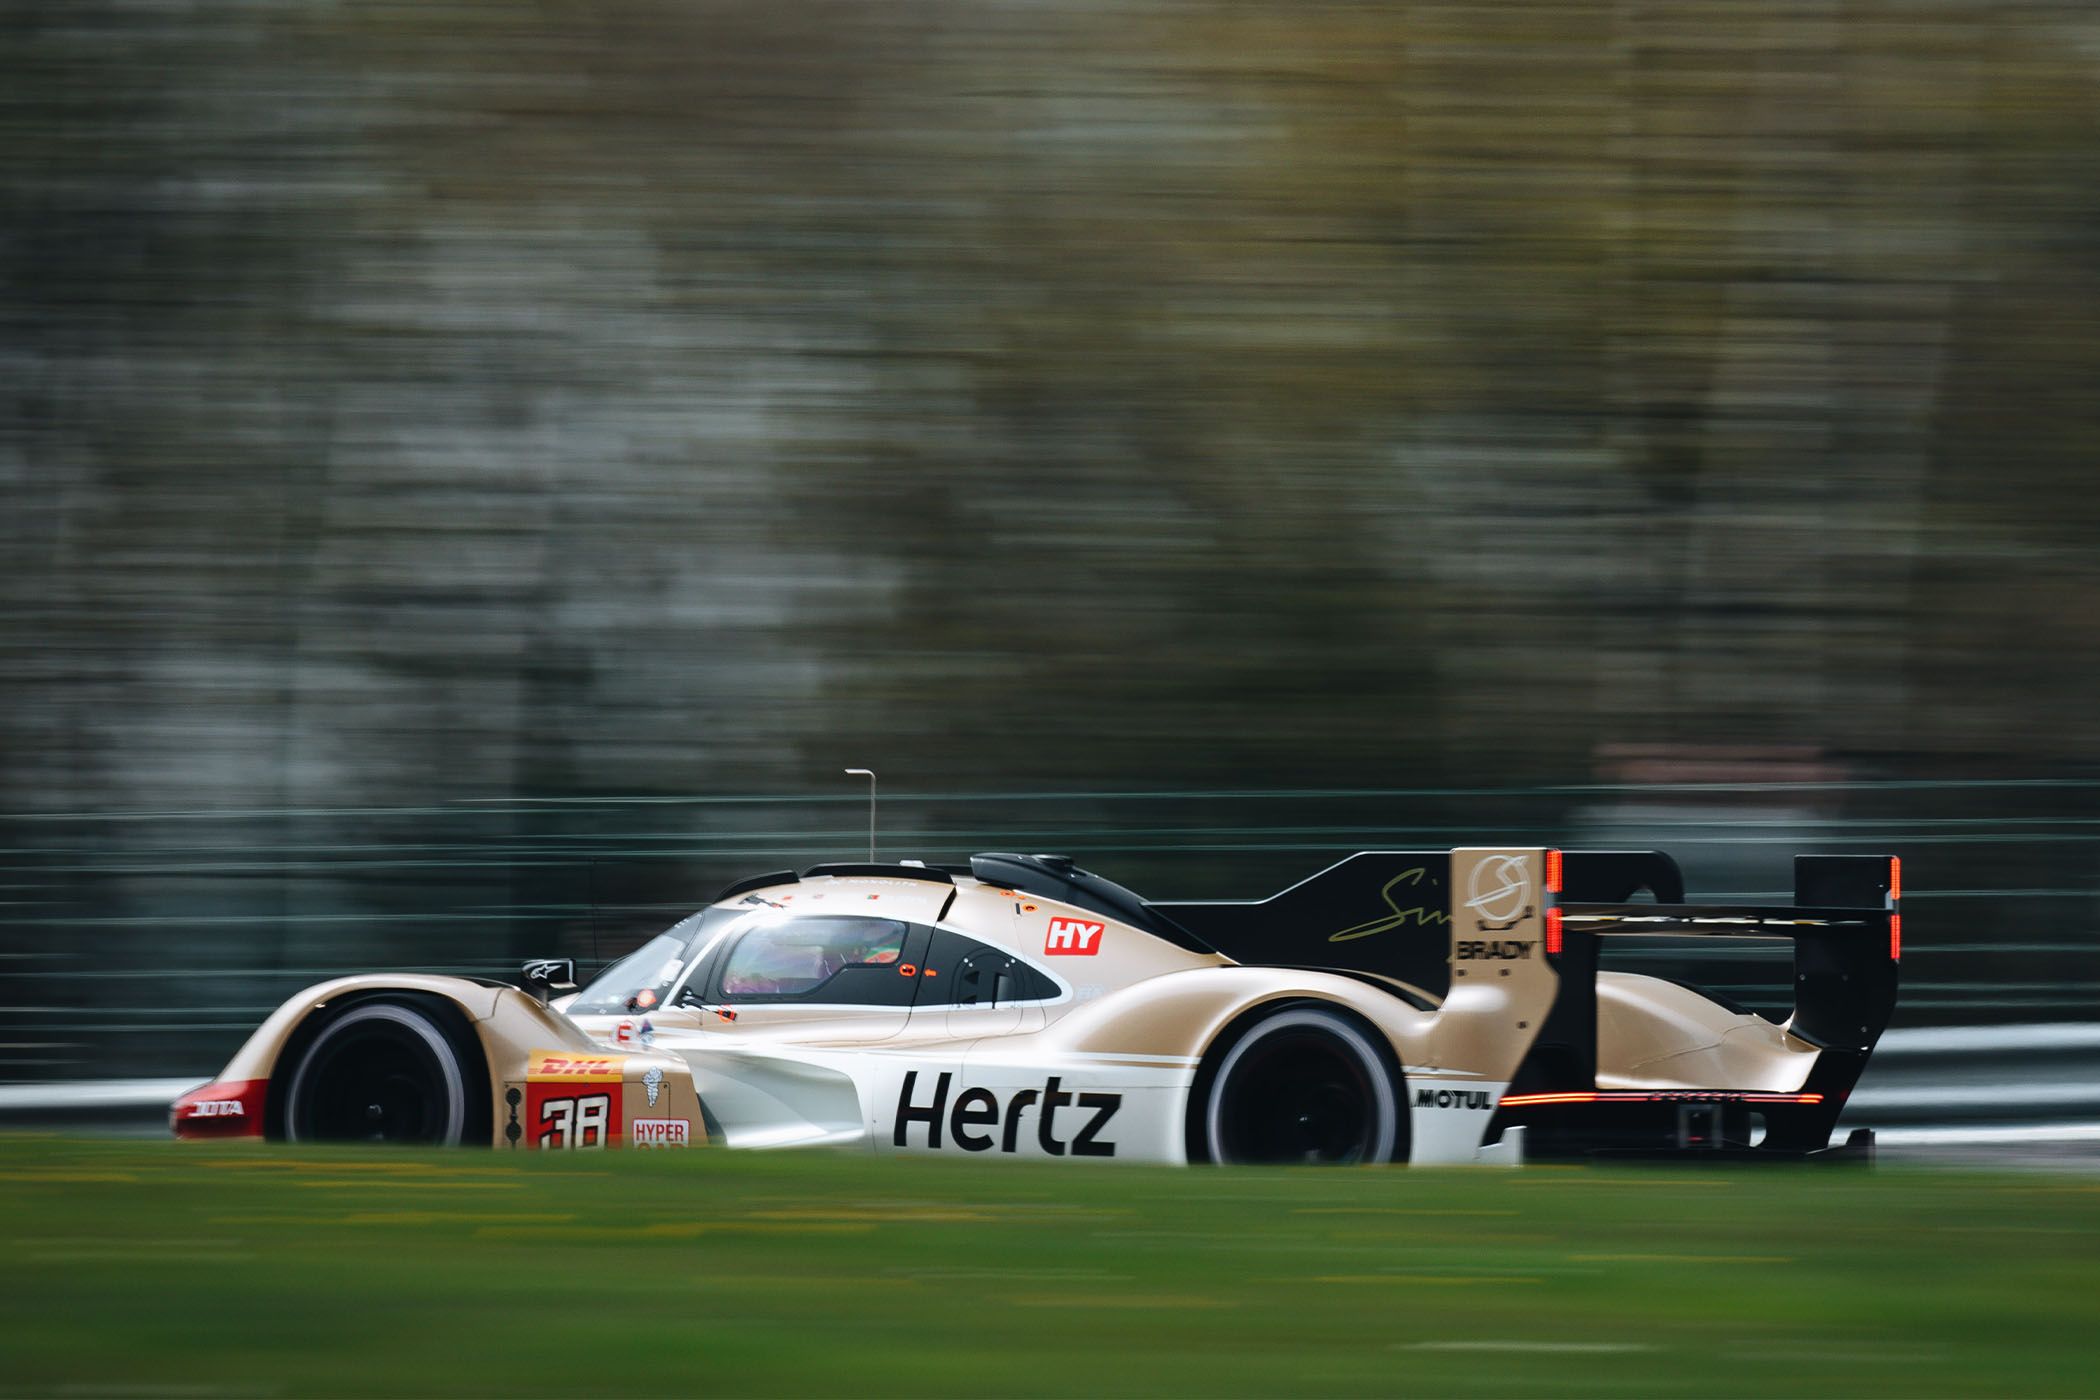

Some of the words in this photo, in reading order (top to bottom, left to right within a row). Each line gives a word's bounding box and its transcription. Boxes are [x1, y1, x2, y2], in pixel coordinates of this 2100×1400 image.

[1048, 921, 1101, 949] HY
[1456, 941, 1535, 959] BRADY
[540, 1058, 610, 1075] DHL
[187, 1101, 245, 1117] JOTA
[1412, 1089, 1492, 1110] MOTUL
[540, 1094, 611, 1150] 38
[894, 1070, 1123, 1157] Hertz
[636, 1124, 684, 1142] HYPER
